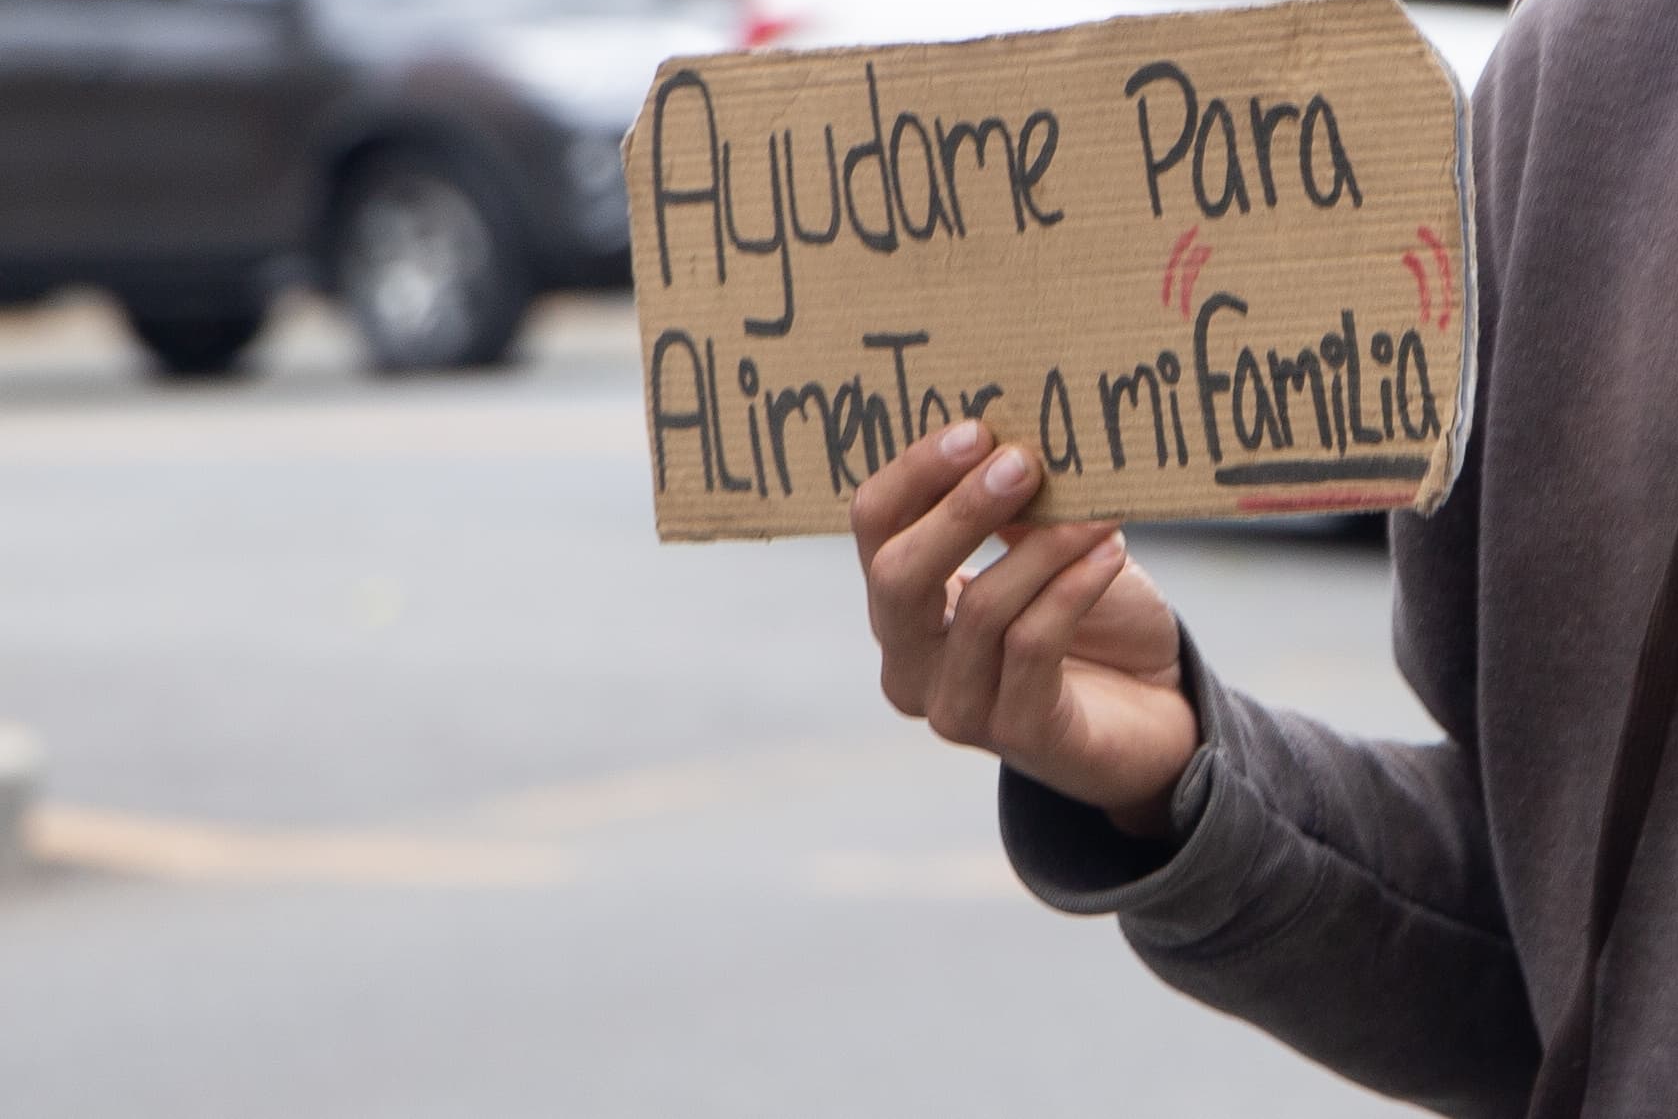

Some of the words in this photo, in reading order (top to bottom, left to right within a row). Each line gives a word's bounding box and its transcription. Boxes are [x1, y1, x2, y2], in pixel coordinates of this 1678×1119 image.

[653, 60, 1064, 335] Ayudame
[1124, 60, 1364, 218] Para
[1039, 365, 1083, 474] a
[1099, 349, 1188, 469] mi
